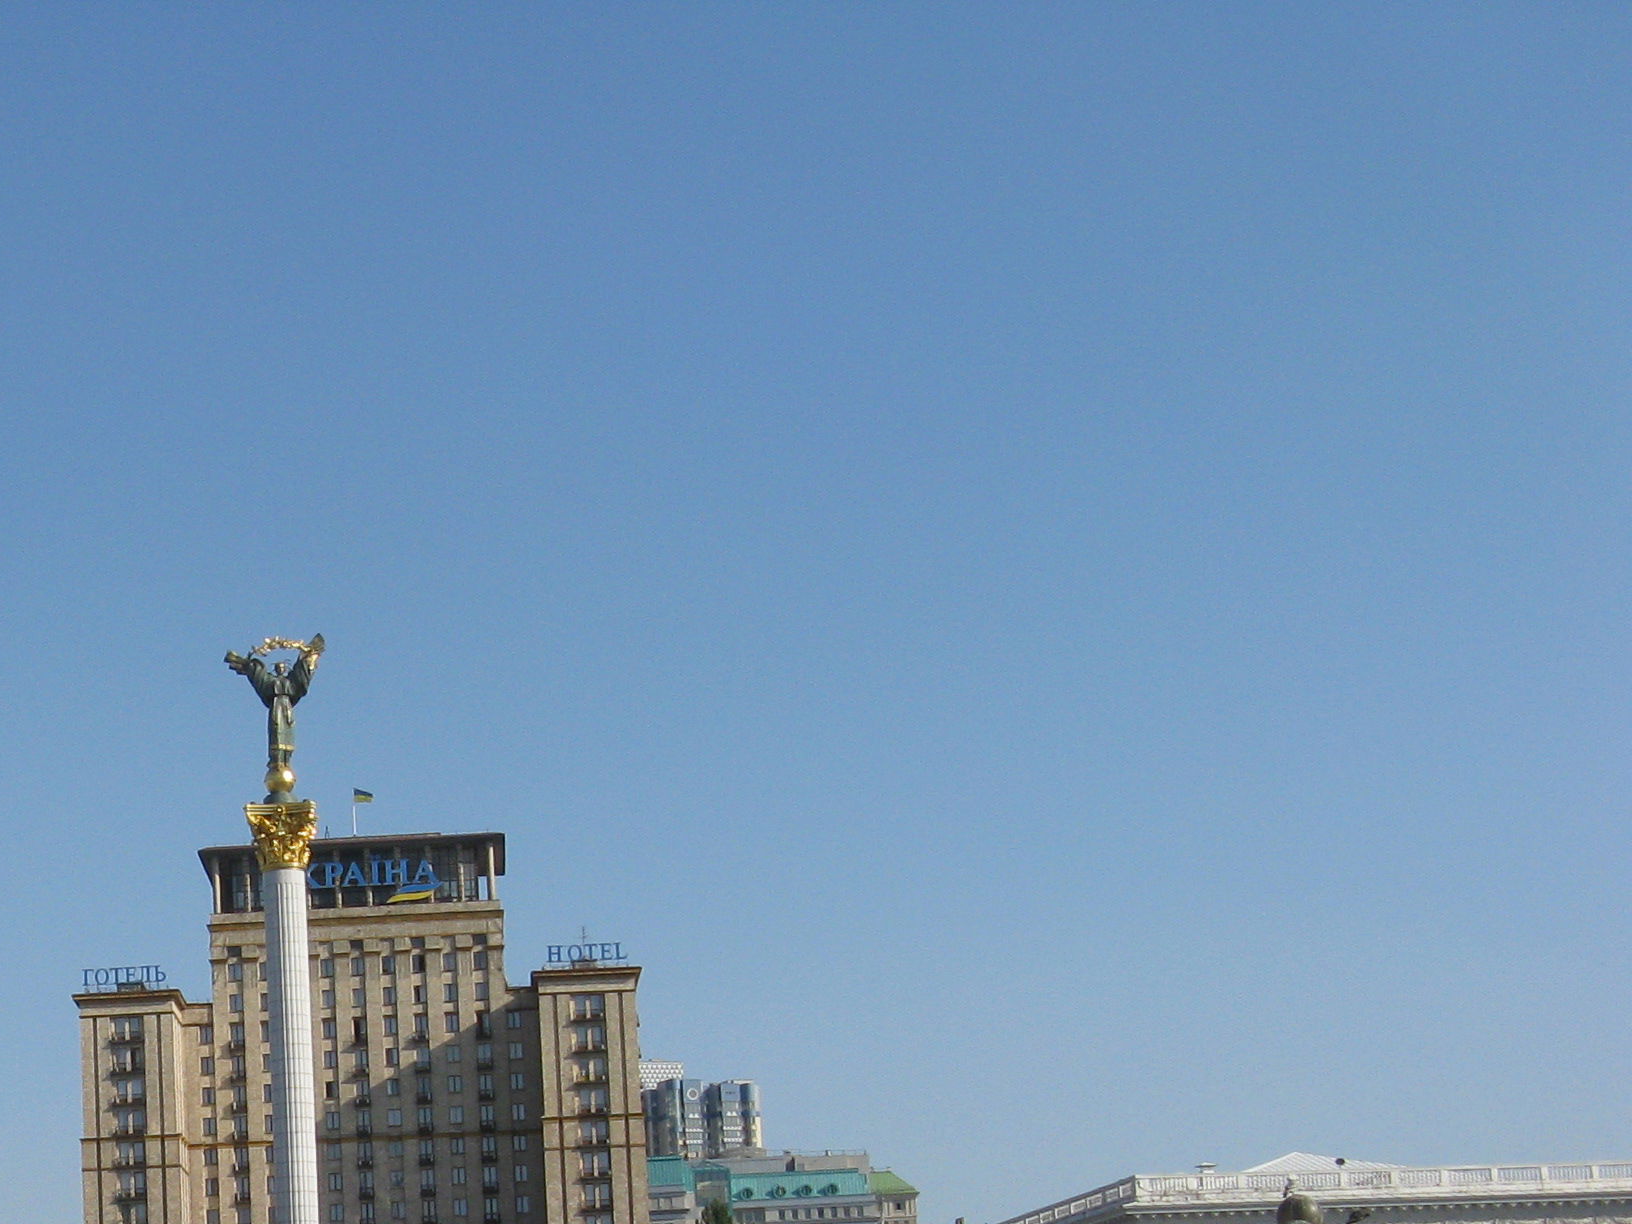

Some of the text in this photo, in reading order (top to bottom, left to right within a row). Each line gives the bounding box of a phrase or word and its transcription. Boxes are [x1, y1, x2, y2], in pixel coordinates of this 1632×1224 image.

[306, 855, 439, 888] КРАЇНА
[546, 942, 627, 963] HOTEL
[82, 965, 167, 987] ГОТЕЛЬ
